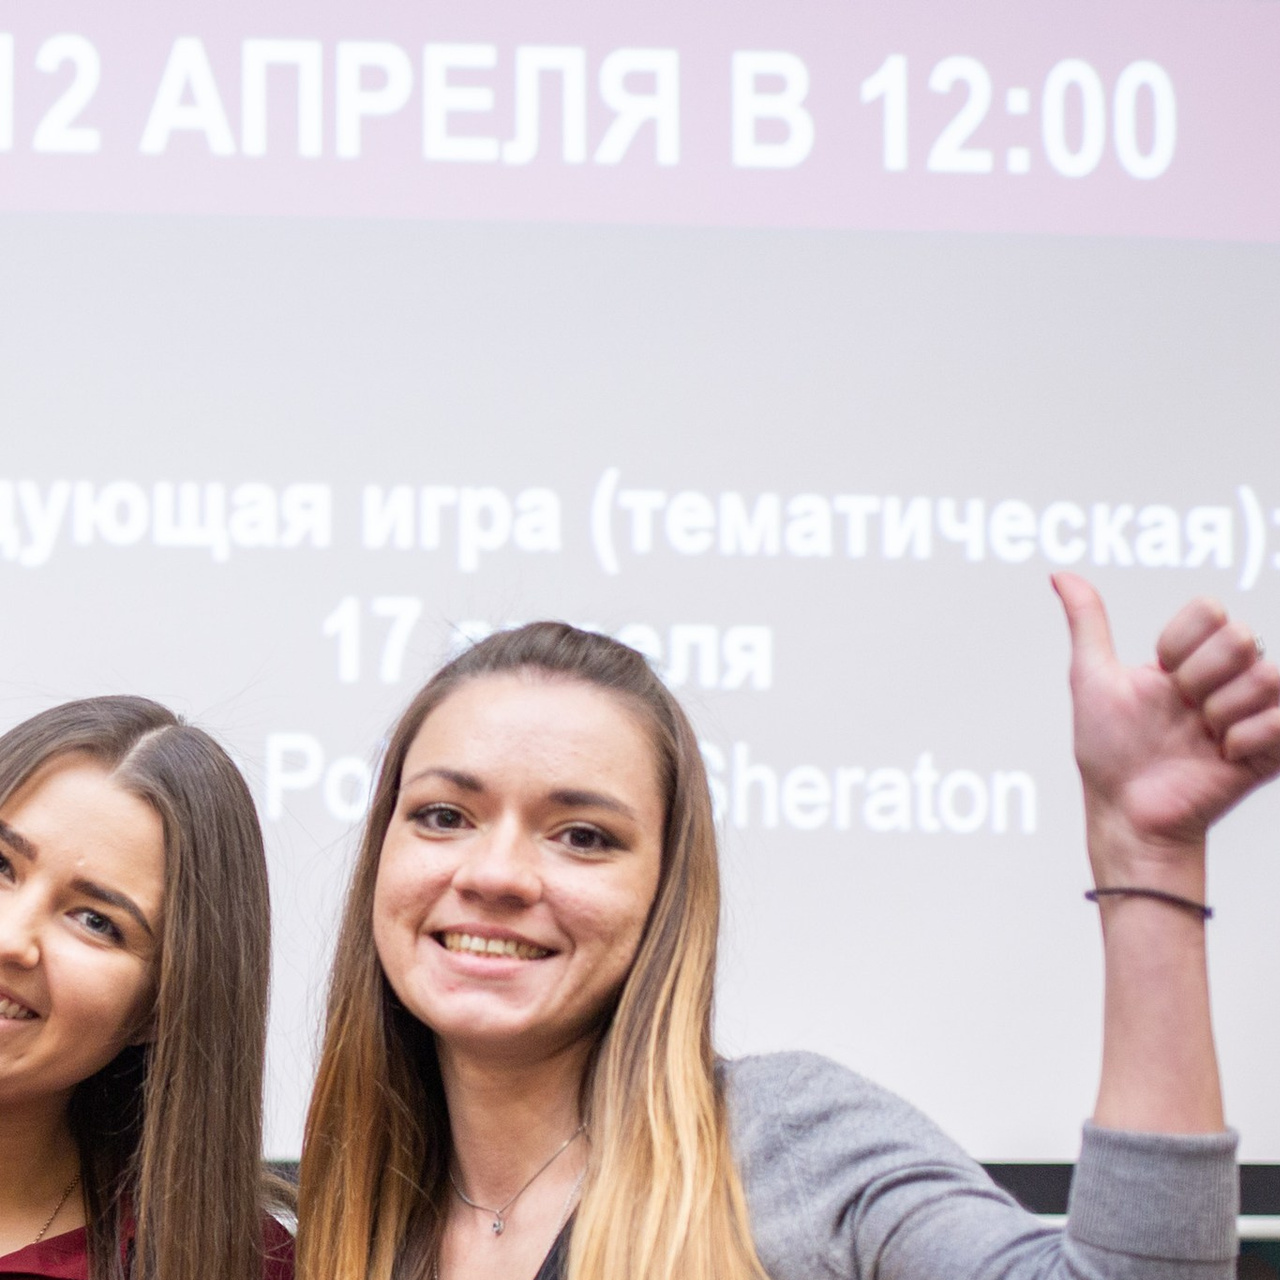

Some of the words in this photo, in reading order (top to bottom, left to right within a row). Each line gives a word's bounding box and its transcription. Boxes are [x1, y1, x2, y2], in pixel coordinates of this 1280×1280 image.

[138, 36, 680, 167] АПРЕЛЯ
[730, 50, 816, 168] В
[859, 53, 1178, 180] 12:00
[362, 484, 563, 574] игра
[322, 596, 423, 685] 17
[449, 618, 774, 691] еля
